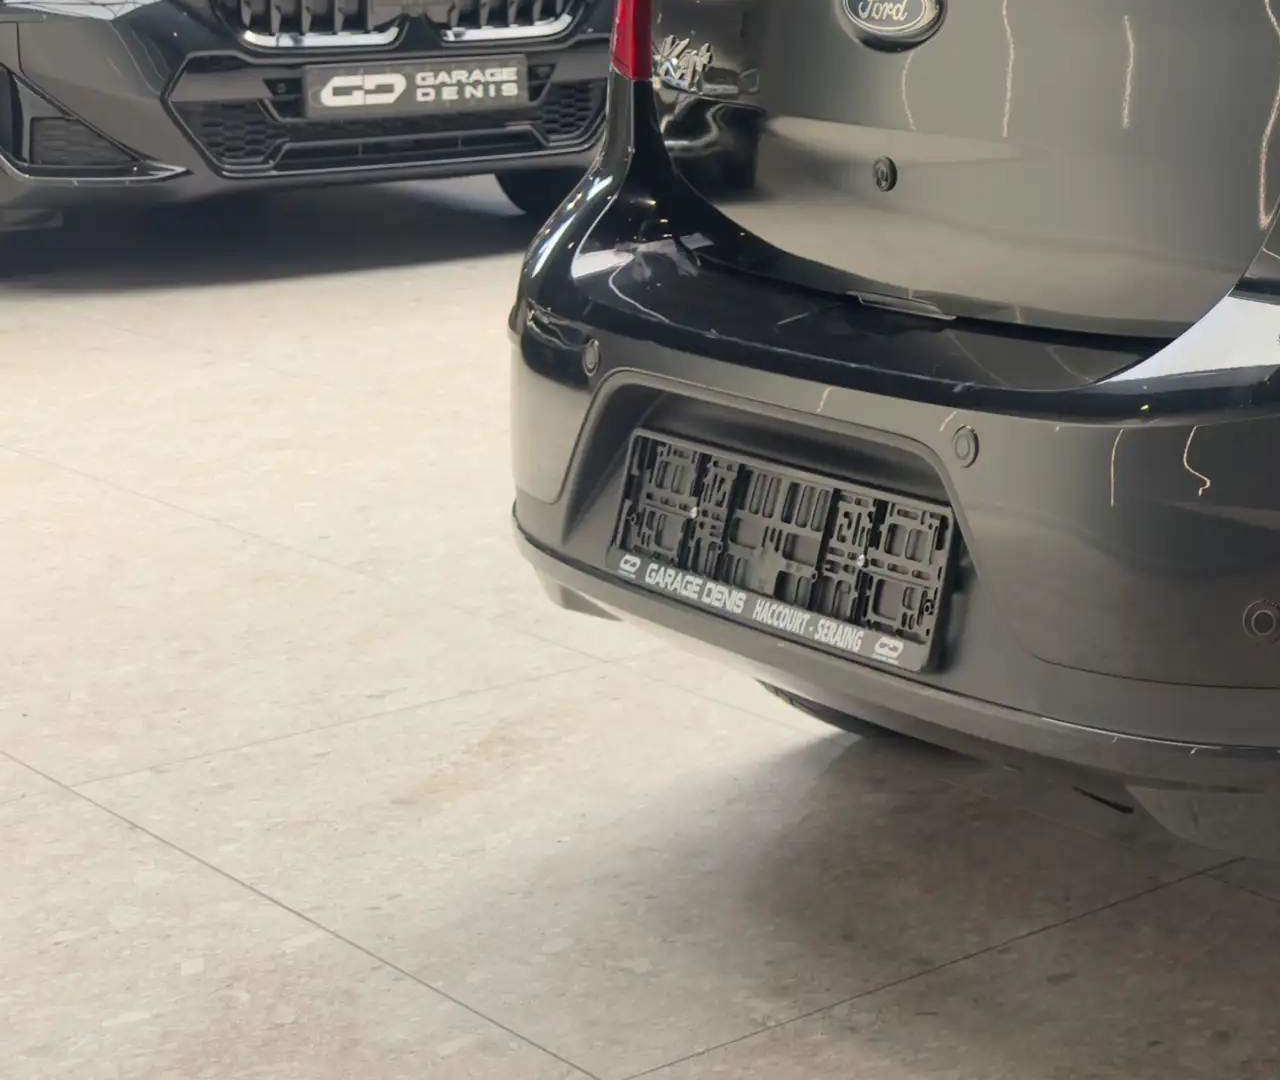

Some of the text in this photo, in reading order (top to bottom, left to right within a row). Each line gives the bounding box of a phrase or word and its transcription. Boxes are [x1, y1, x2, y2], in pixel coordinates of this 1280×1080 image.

[415, 67, 518, 86] GARAGE
[415, 83, 518, 102] DENIS
[644, 562, 703, 600] GARAGE
[701, 581, 747, 614] DENIS
[752, 599, 810, 635] HACCOURT
[814, 618, 864, 652] SERAING
